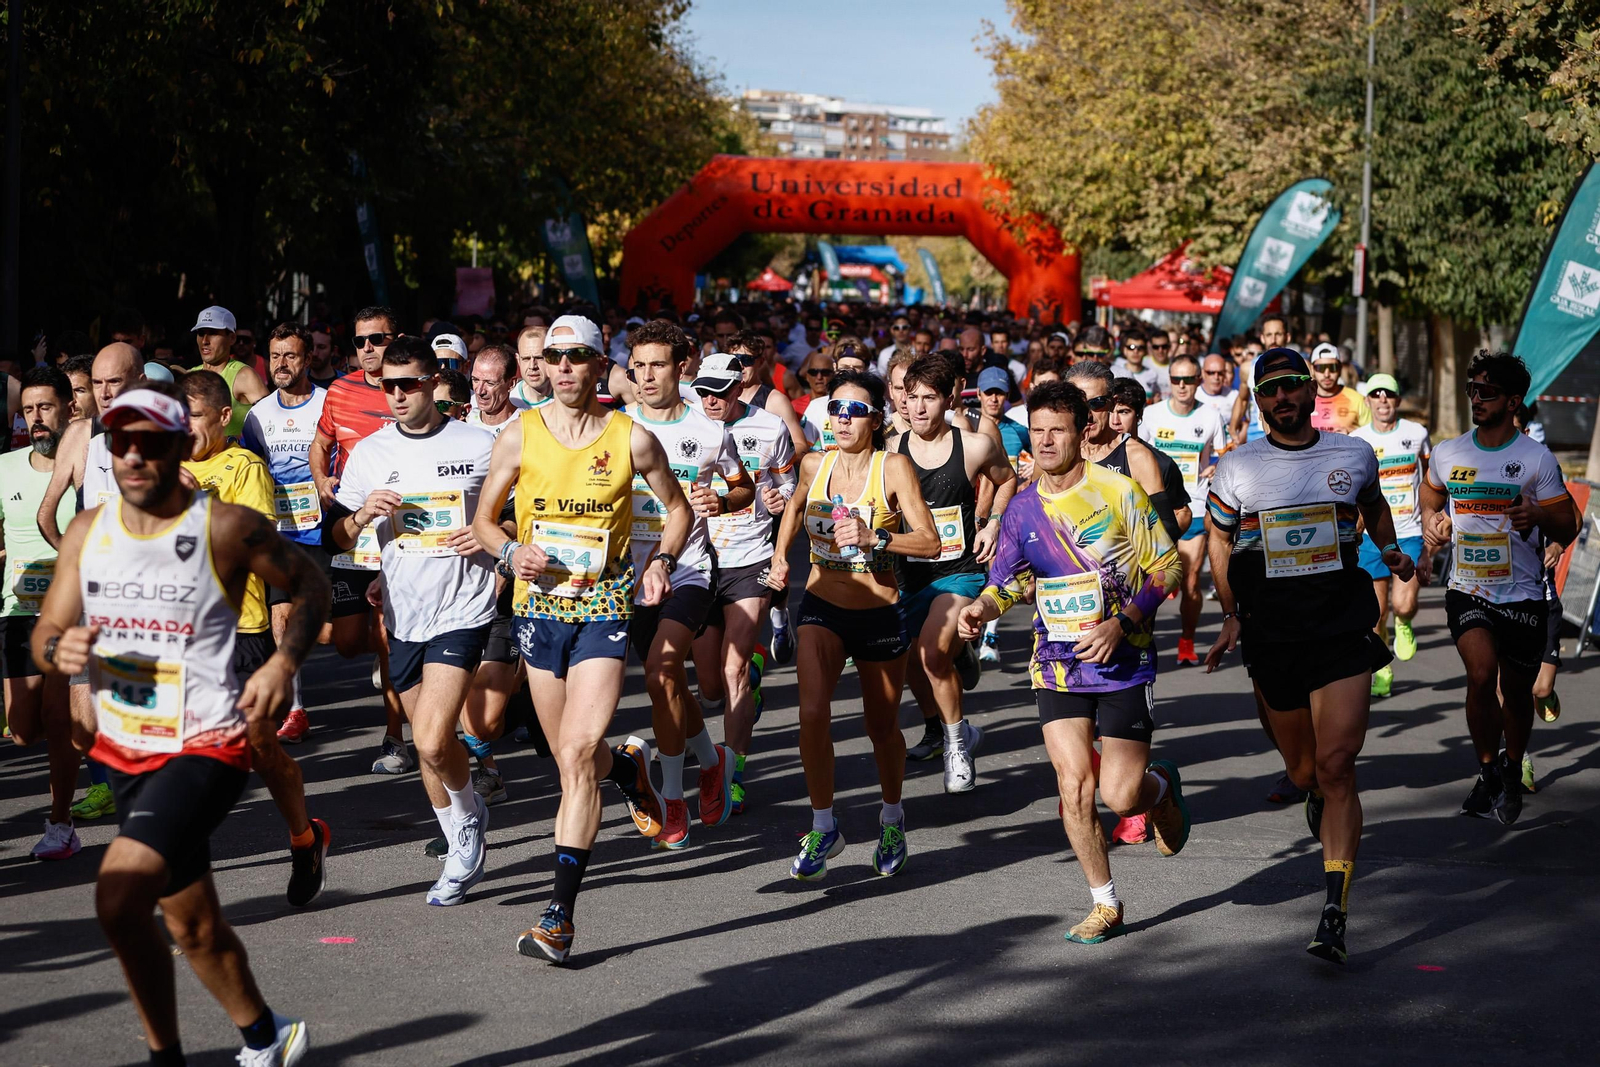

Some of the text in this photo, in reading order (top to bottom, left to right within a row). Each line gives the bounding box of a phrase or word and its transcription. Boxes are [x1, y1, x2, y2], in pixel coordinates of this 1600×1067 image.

[750, 172, 963, 199] Universidad
[753, 200, 956, 224] de Granada
[658, 194, 730, 253] Deportes
[267, 443, 310, 454] MARACEN
[1155, 441, 1199, 450] CARRERA
[1380, 456, 1412, 465] RRERA
[437, 464, 475, 477] DMF
[1450, 469, 1477, 481] 11ª
[1386, 494, 1406, 504] 67
[1449, 486, 1511, 497] CARRERA
[280, 497, 311, 512] 552
[557, 498, 614, 516] Vigilsa
[402, 510, 452, 529] 965
[815, 520, 836, 535] 14
[1285, 527, 1317, 547] 67
[1464, 547, 1501, 562] 528
[24, 577, 51, 593] 59
[1067, 578, 1097, 587] UNIVERSIDAD
[1044, 593, 1096, 615] 1145
